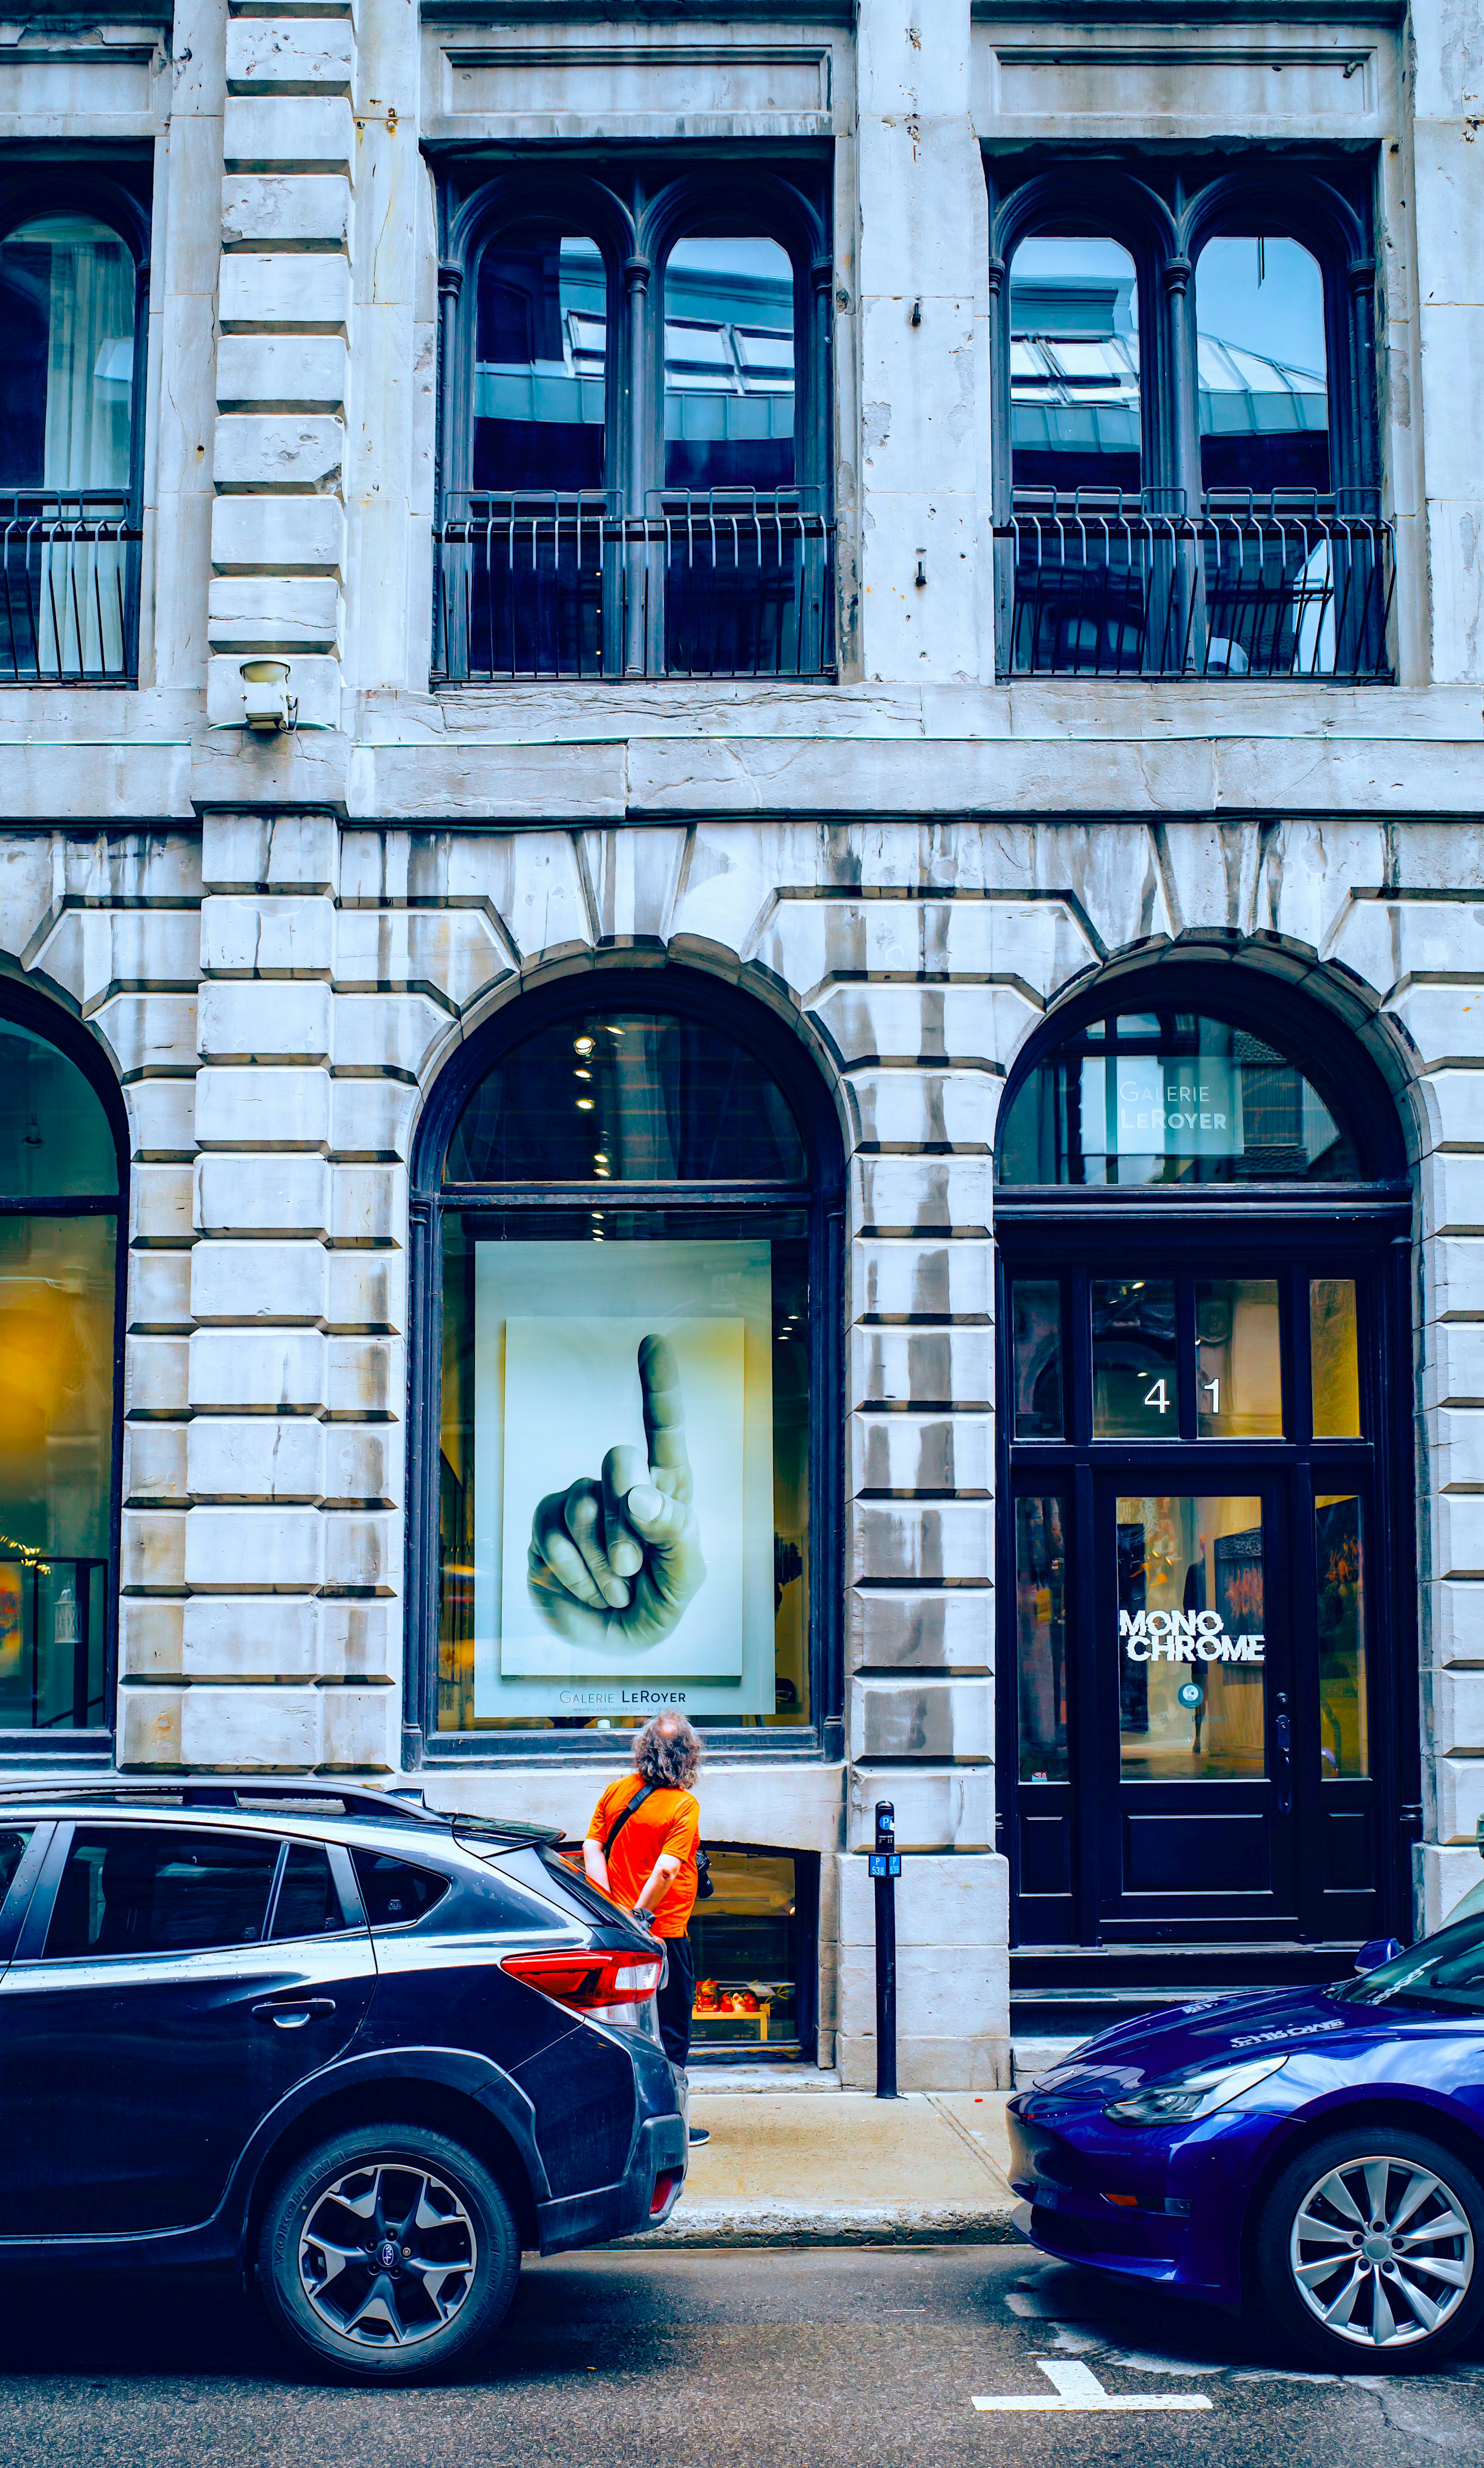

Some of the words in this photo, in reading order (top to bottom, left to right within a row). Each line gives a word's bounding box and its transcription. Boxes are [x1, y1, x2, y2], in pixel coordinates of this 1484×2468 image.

[1119, 1081, 1210, 1102] GALERIE
[1120, 1109, 1227, 1129] LEROYER
[1119, 1609, 1224, 1636] MONO
[1126, 1635, 1266, 1661] CHROME
[560, 1691, 614, 1703] GALERIE
[622, 1690, 686, 1703] LEROYER
[883, 1817, 889, 1827] P
[872, 1866, 884, 1875] 538
[890, 1865, 899, 1874] 539
[274, 2150, 346, 2264] YOKOHAMA
